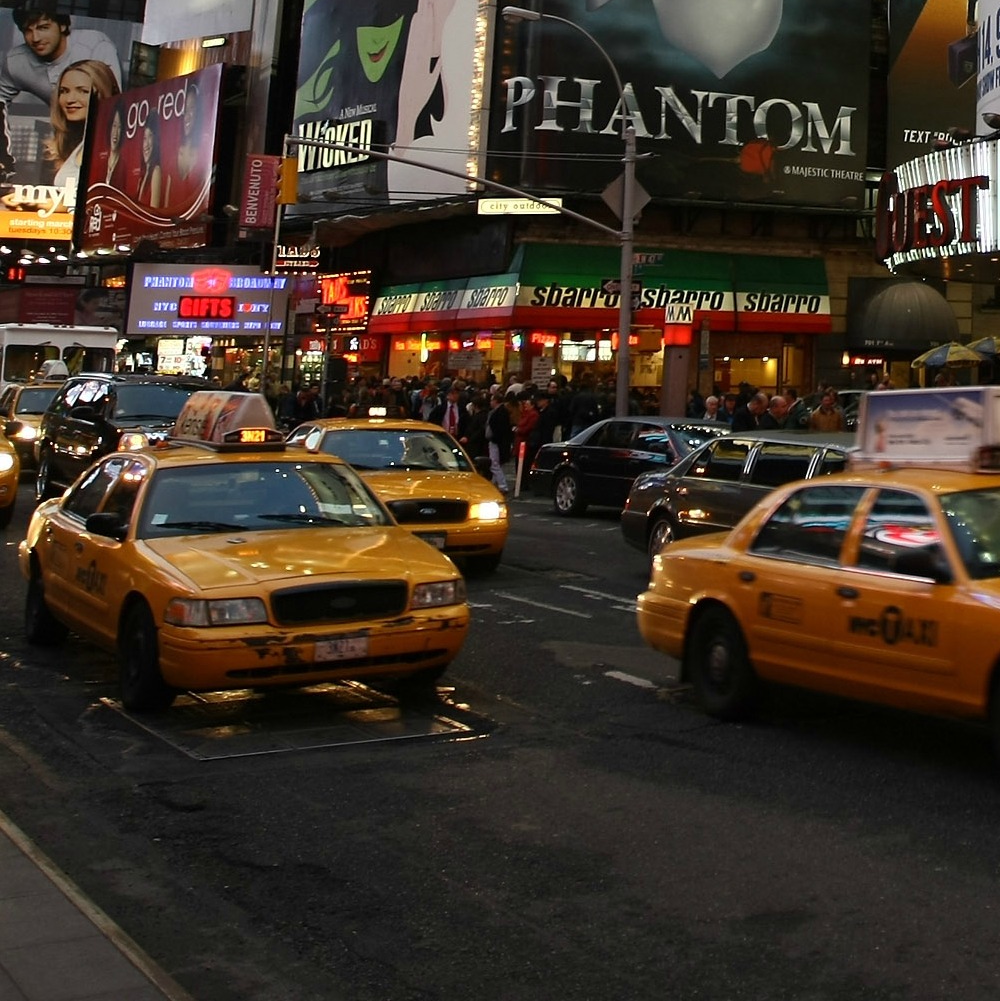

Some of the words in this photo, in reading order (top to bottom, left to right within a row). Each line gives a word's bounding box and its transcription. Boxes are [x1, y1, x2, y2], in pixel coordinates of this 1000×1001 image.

[126, 98, 149, 139] go
[157, 79, 188, 121] red
[500, 75, 857, 156] PHANTOM
[903, 129, 931, 144] TEXT
[791, 165, 830, 179] MAJESTIC
[831, 169, 864, 182] THEATRE
[245, 158, 263, 225] BENVENUTO
[489, 201, 508, 211] city
[513, 200, 550, 210] outdoo
[9, 218, 45, 229] starting
[378, 294, 412, 315] sbarro
[420, 290, 458, 313] sbarro
[466, 286, 509, 309] sbarro
[531, 283, 621, 309] sbarro
[641, 284, 724, 311] sbarro
[744, 290, 821, 315] sbarro
[180, 299, 232, 317] GIFTS
[531, 332, 557, 344] Pizza
[241, 430, 265, 442] 3N21
